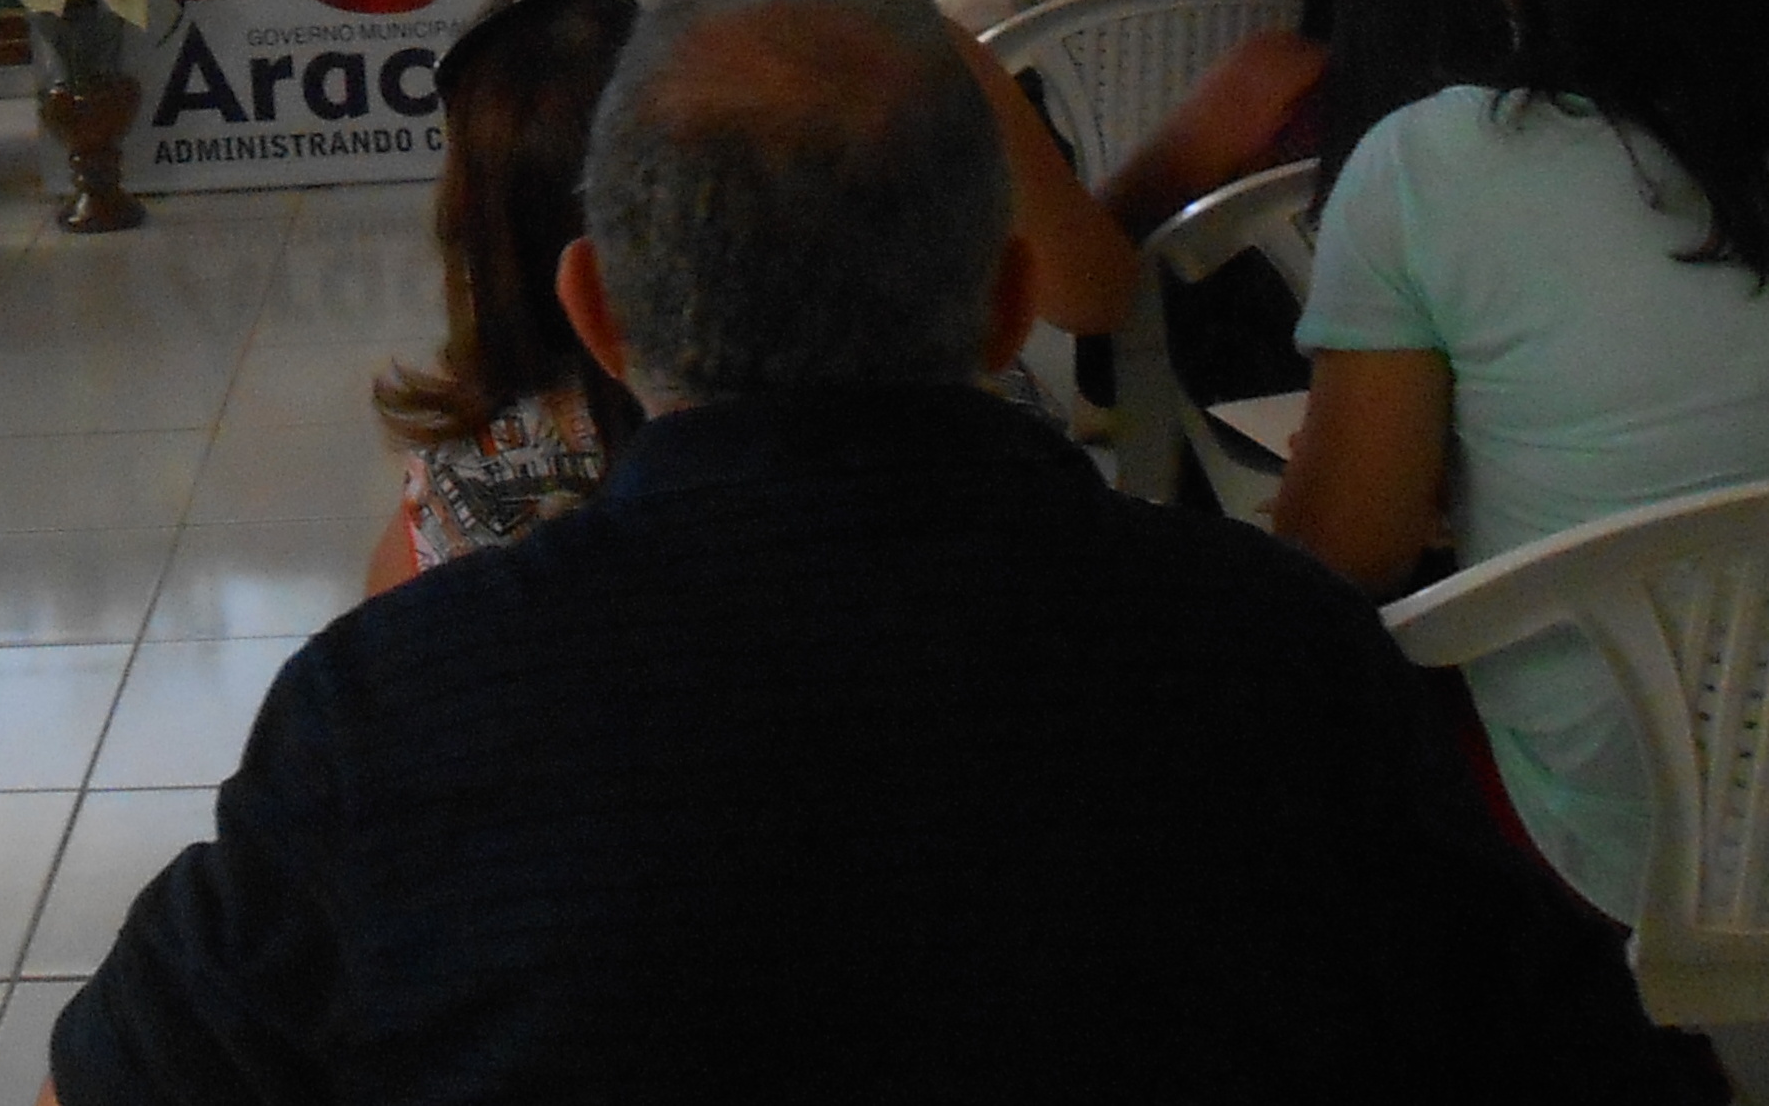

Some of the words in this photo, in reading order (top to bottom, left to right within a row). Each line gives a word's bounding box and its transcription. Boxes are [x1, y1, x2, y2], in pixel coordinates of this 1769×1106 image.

[246, 24, 355, 47] GOVERNO
[358, 18, 463, 43] MUNICIPA
[152, 21, 443, 128] Arac
[153, 128, 415, 166] ADMINISTRANDO
[426, 127, 444, 153] C
